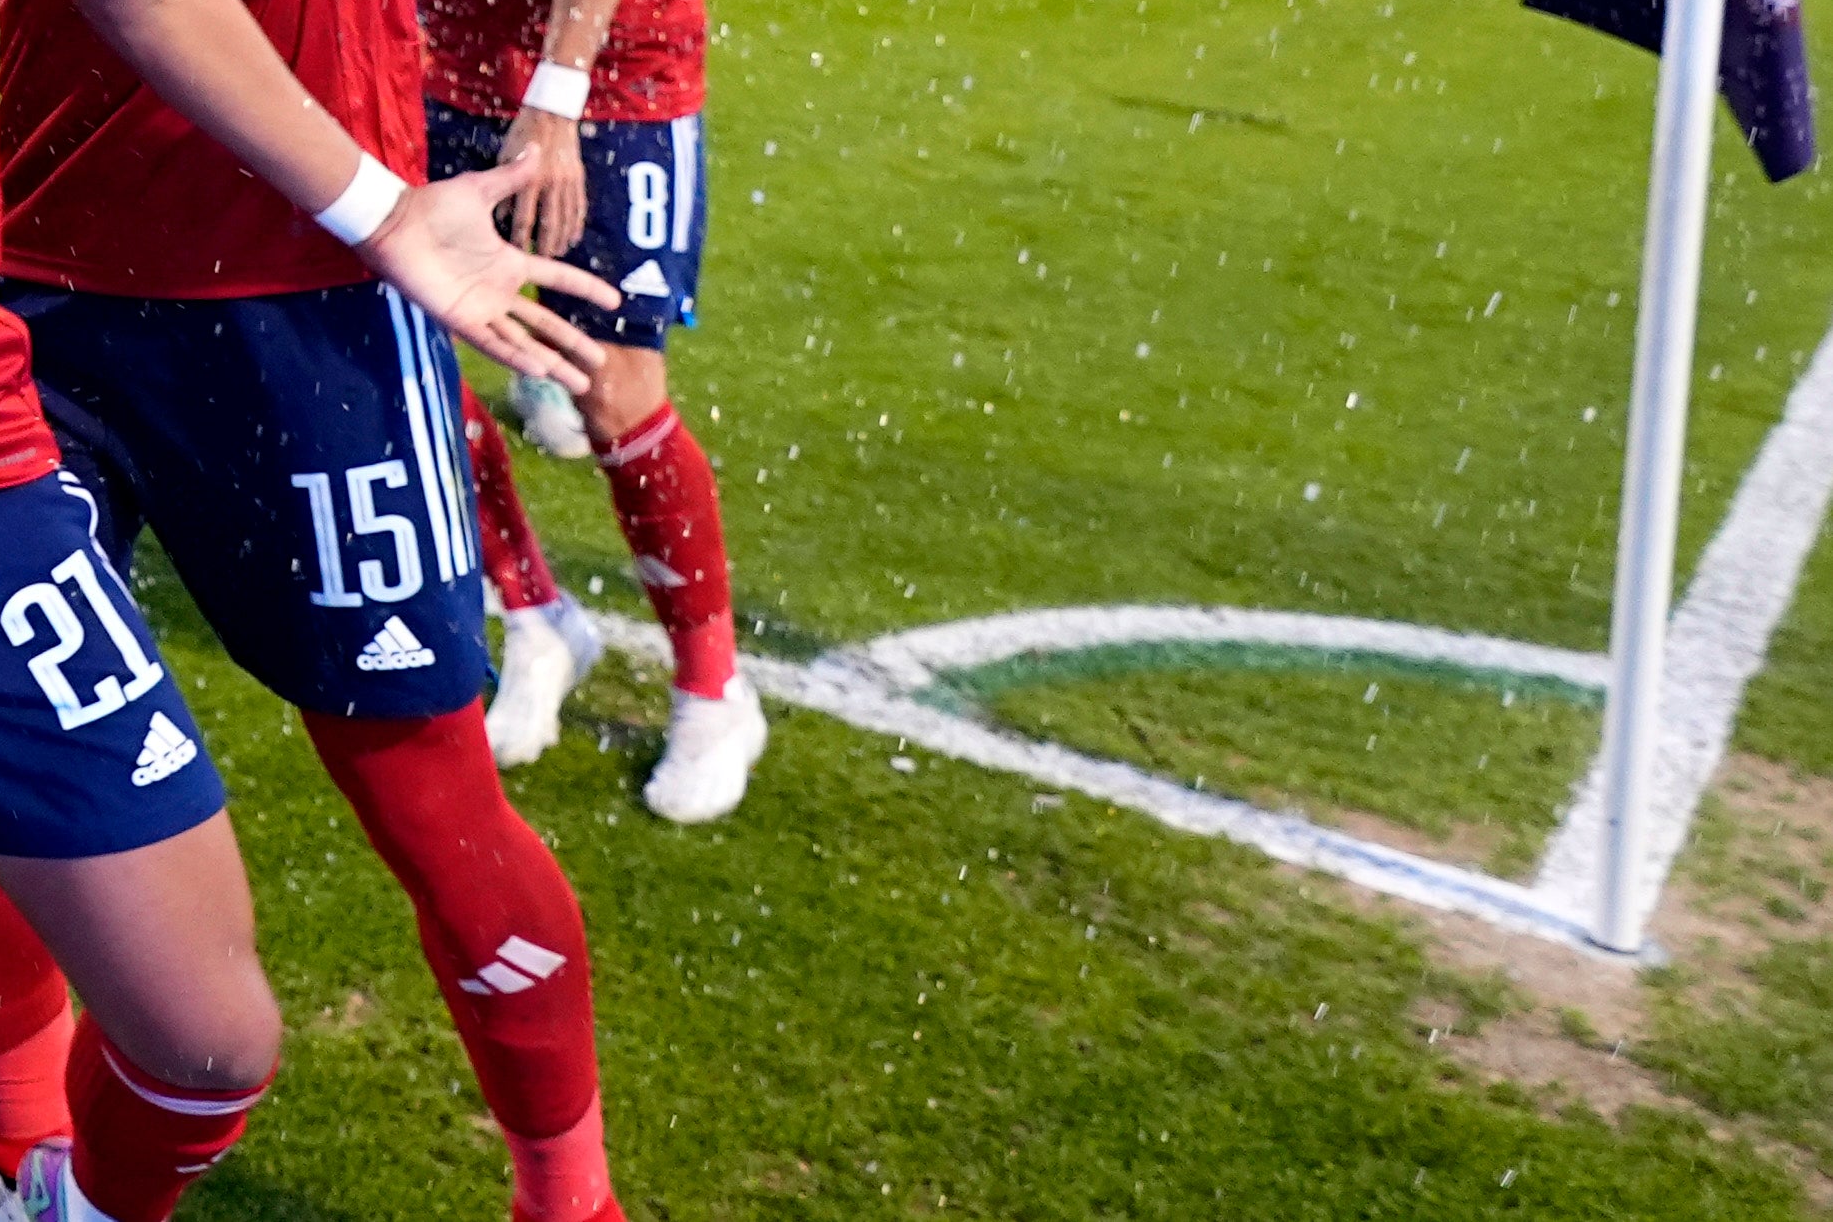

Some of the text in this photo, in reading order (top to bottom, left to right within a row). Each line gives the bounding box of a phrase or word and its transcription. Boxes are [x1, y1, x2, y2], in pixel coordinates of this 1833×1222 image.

[627, 161, 668, 250] 8
[291, 459, 424, 608] 15
[0, 549, 164, 731] 21
[356, 648, 436, 671] adidas
[131, 739, 198, 787] adidas
